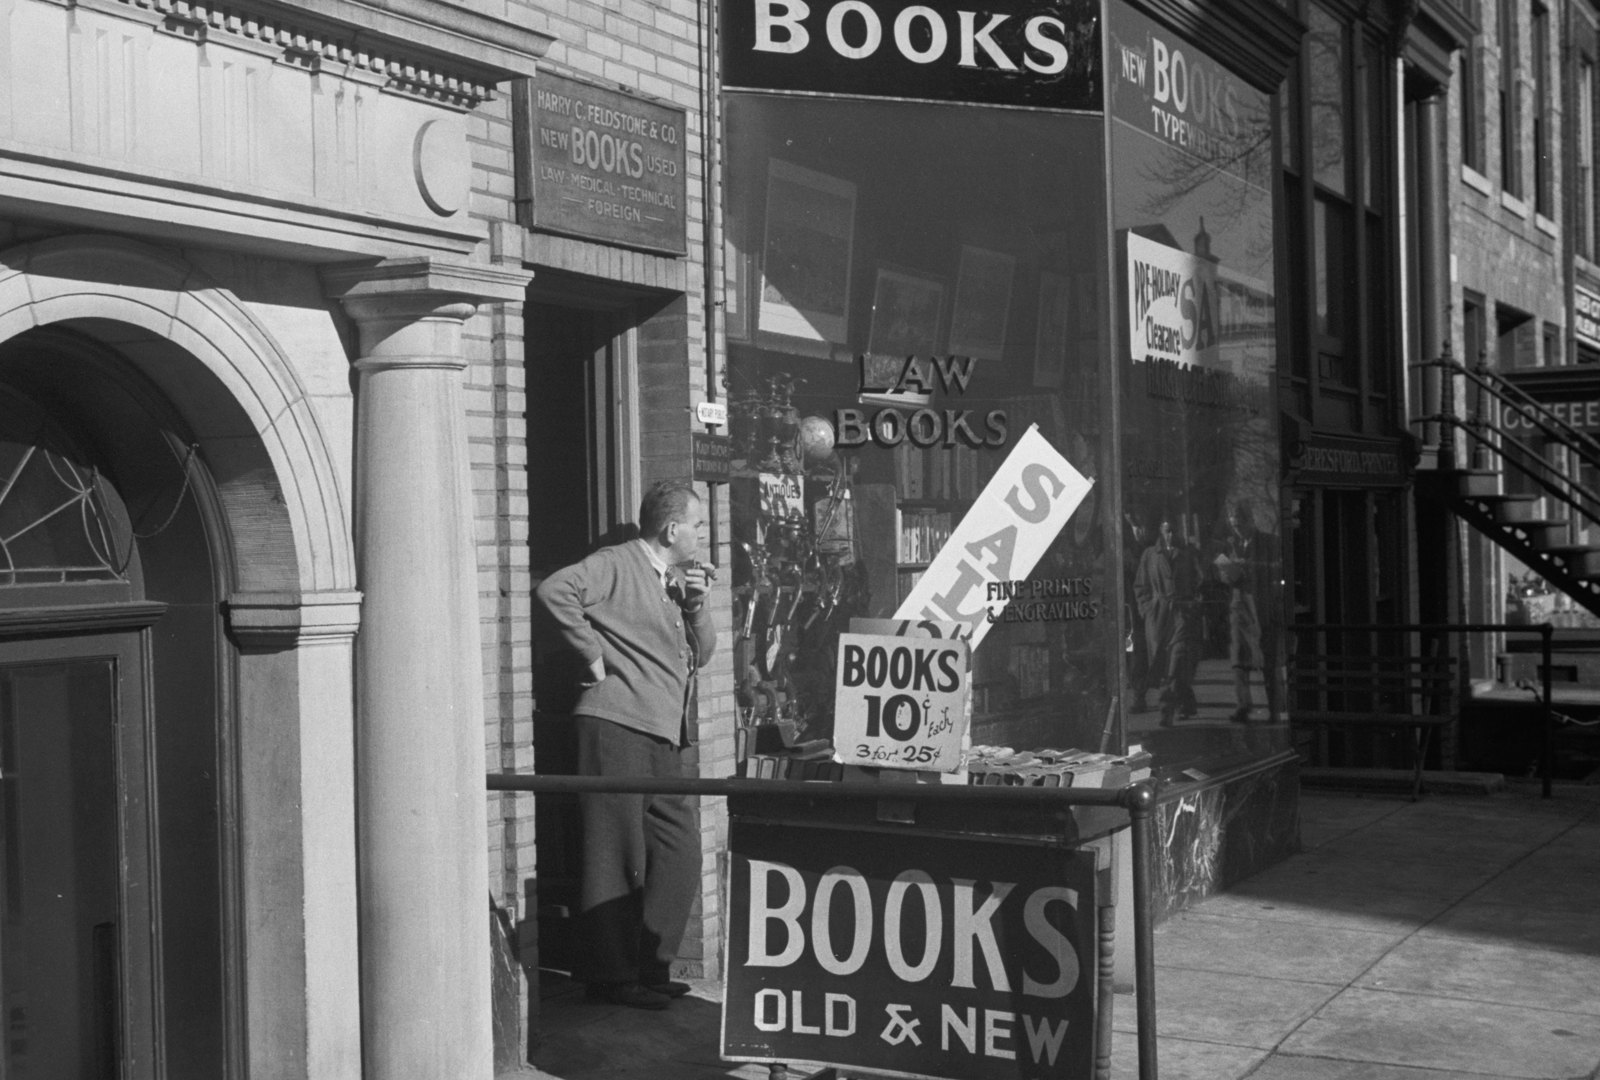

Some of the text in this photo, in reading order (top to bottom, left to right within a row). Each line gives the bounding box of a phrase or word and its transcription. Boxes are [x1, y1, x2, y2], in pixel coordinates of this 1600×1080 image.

[752, 0, 1069, 75] BOOKS
[1121, 36, 1239, 142] NEW BOOKS
[537, 90, 571, 116] HARRY
[588, 104, 648, 137] FELDSTONE
[649, 121, 658, 139] &
[661, 124, 678, 145] CO.
[540, 126, 677, 179] NEW BOOKS USED
[541, 166, 676, 210] LAW MEDICAL TECHNICAL
[588, 199, 641, 222] FOREIGN
[1146, 315, 1181, 356] Clearance
[859, 354, 977, 395] LAW
[834, 408, 1007, 448] BOOKS
[1503, 402, 1598, 429] COFFEE
[920, 463, 1066, 633] SAL
[987, 578, 1092, 601] FINE PRINTS
[986, 601, 1098, 624] & ENGRAVINGS
[843, 644, 960, 693] BOOKS
[856, 744, 871, 758] 3
[902, 745, 942, 765] 25¢
[743, 858, 1080, 999] BOOKS
[754, 987, 1070, 1067] OLD & NEW
